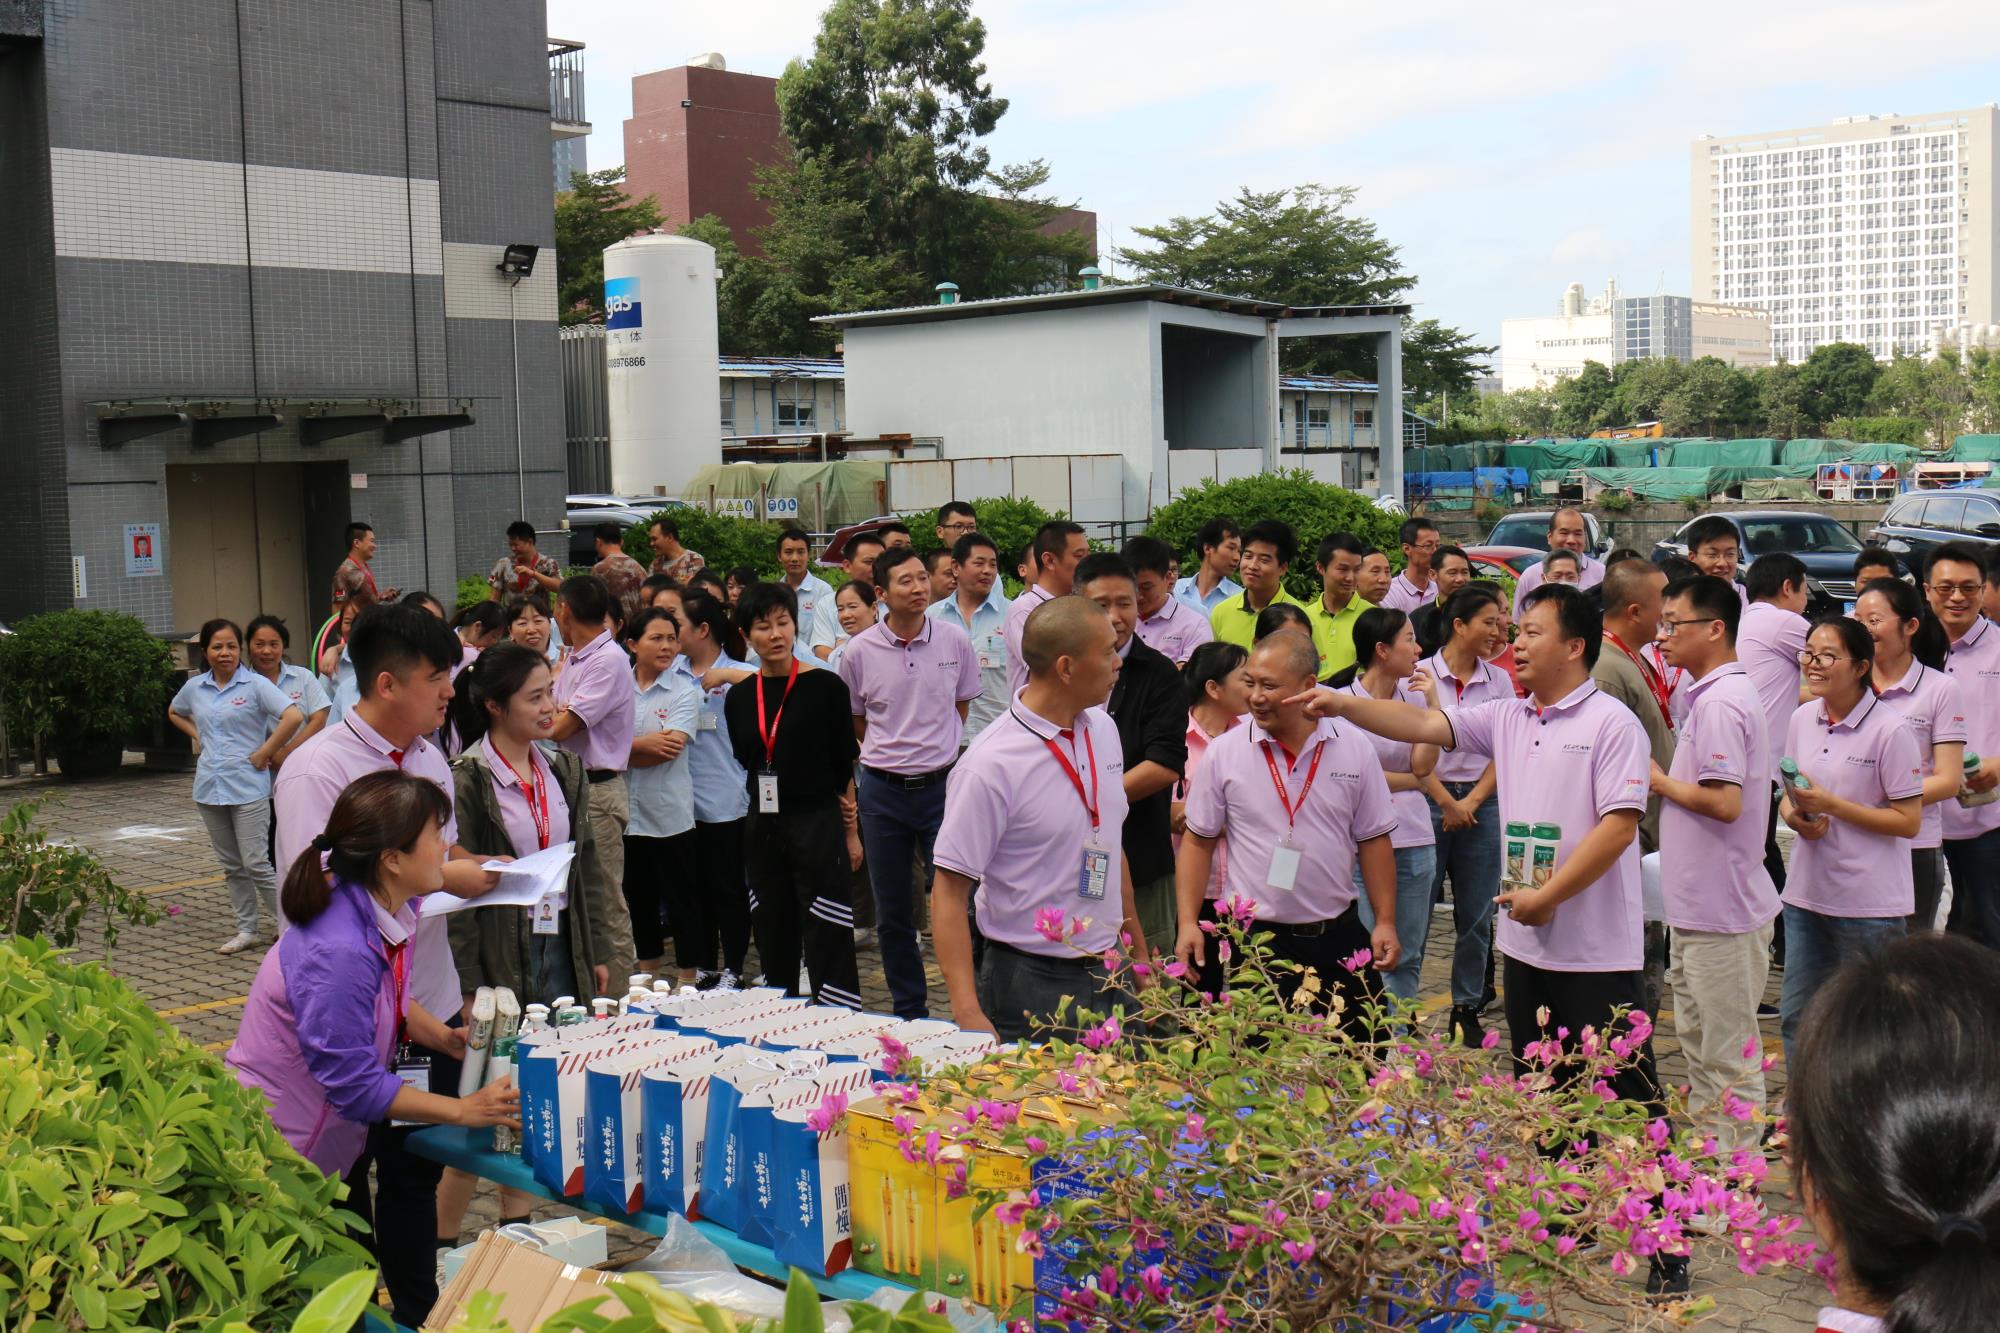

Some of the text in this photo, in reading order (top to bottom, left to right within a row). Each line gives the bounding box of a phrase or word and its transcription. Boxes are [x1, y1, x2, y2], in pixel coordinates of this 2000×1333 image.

[605, 295, 632, 320] gas
[540, 1106, 552, 1153] 云南白药
[601, 1126, 612, 1171] 云南白药
[660, 1135, 671, 1181] 云南白药
[724, 1143, 734, 1189] 云南白药
[754, 1162, 768, 1209] 云南白药
[797, 1179, 810, 1228] 云南白药
